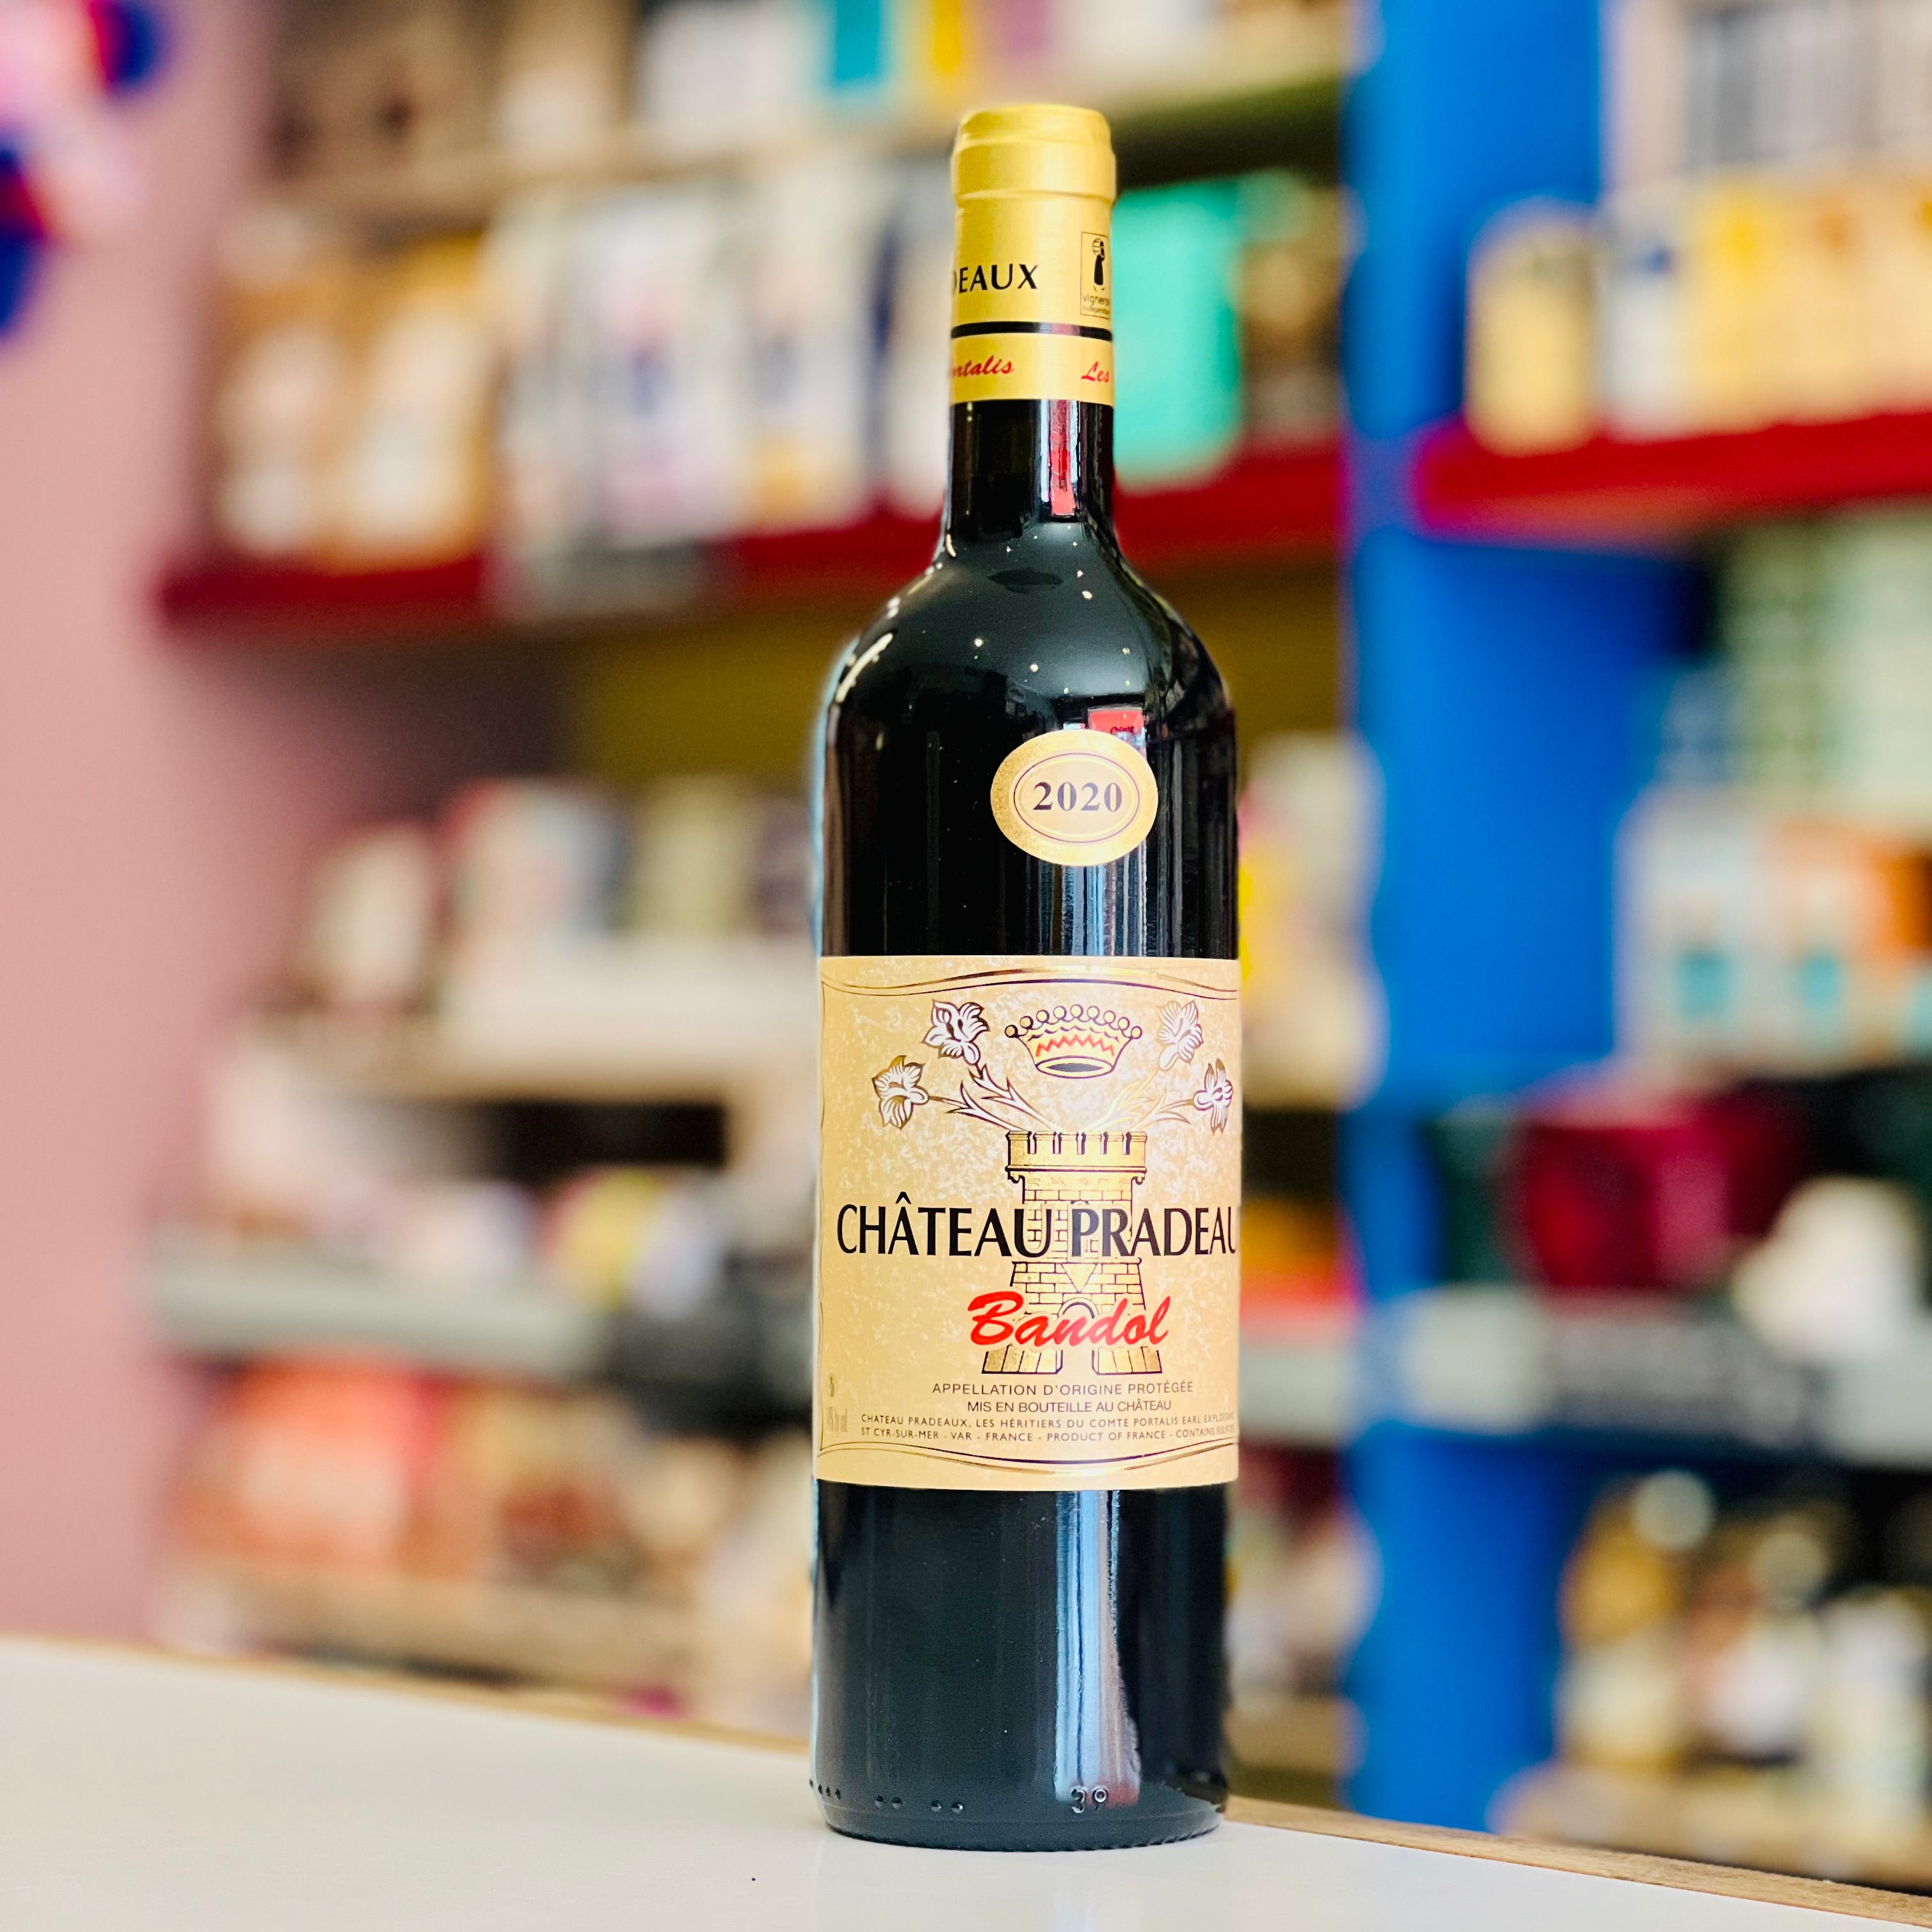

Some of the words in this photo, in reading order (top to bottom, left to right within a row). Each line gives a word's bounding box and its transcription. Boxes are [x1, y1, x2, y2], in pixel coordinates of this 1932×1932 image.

[1081, 360, 1110, 383] Les
[1033, 781, 1123, 812] 2020
[837, 1191, 1051, 1258] CHÂTEAU
[967, 1291, 1170, 1347] Bandol
[932, 1383, 1036, 1395] APPELLATION
[1043, 1384, 1123, 1395] D'ORIGINE
[1128, 1380, 1193, 1394] PROTÉGÉE
[967, 1401, 992, 1413] MIS
[995, 1402, 1015, 1413] EN
[1018, 1402, 1092, 1413] BOUTEILLE
[1096, 1401, 1114, 1413] AU
[1117, 1398, 1172, 1412] CHÂTEAU
[861, 1414, 903, 1425] CHATEAU
[976, 1419, 995, 1428] LES
[1000, 1417, 1061, 1428] HÉRITIERS
[1067, 1419, 1084, 1428] DU
[1089, 1418, 1130, 1428] COMTE
[1133, 1416, 1179, 1426] PORTALIS
[1182, 1414, 1202, 1425] EARL
[861, 1427, 870, 1436] ST
[874, 1428, 939, 1439] CYR-SUR-MER
[951, 1432, 971, 1440] VAR
[986, 1432, 1033, 1441] FRANCE
[1047, 1432, 1103, 1441] PRODUCT
[1109, 1432, 1123, 1441] OF
[1127, 1430, 1166, 1439] FRANCE
[1176, 1427, 1215, 1438] CONTAINS
